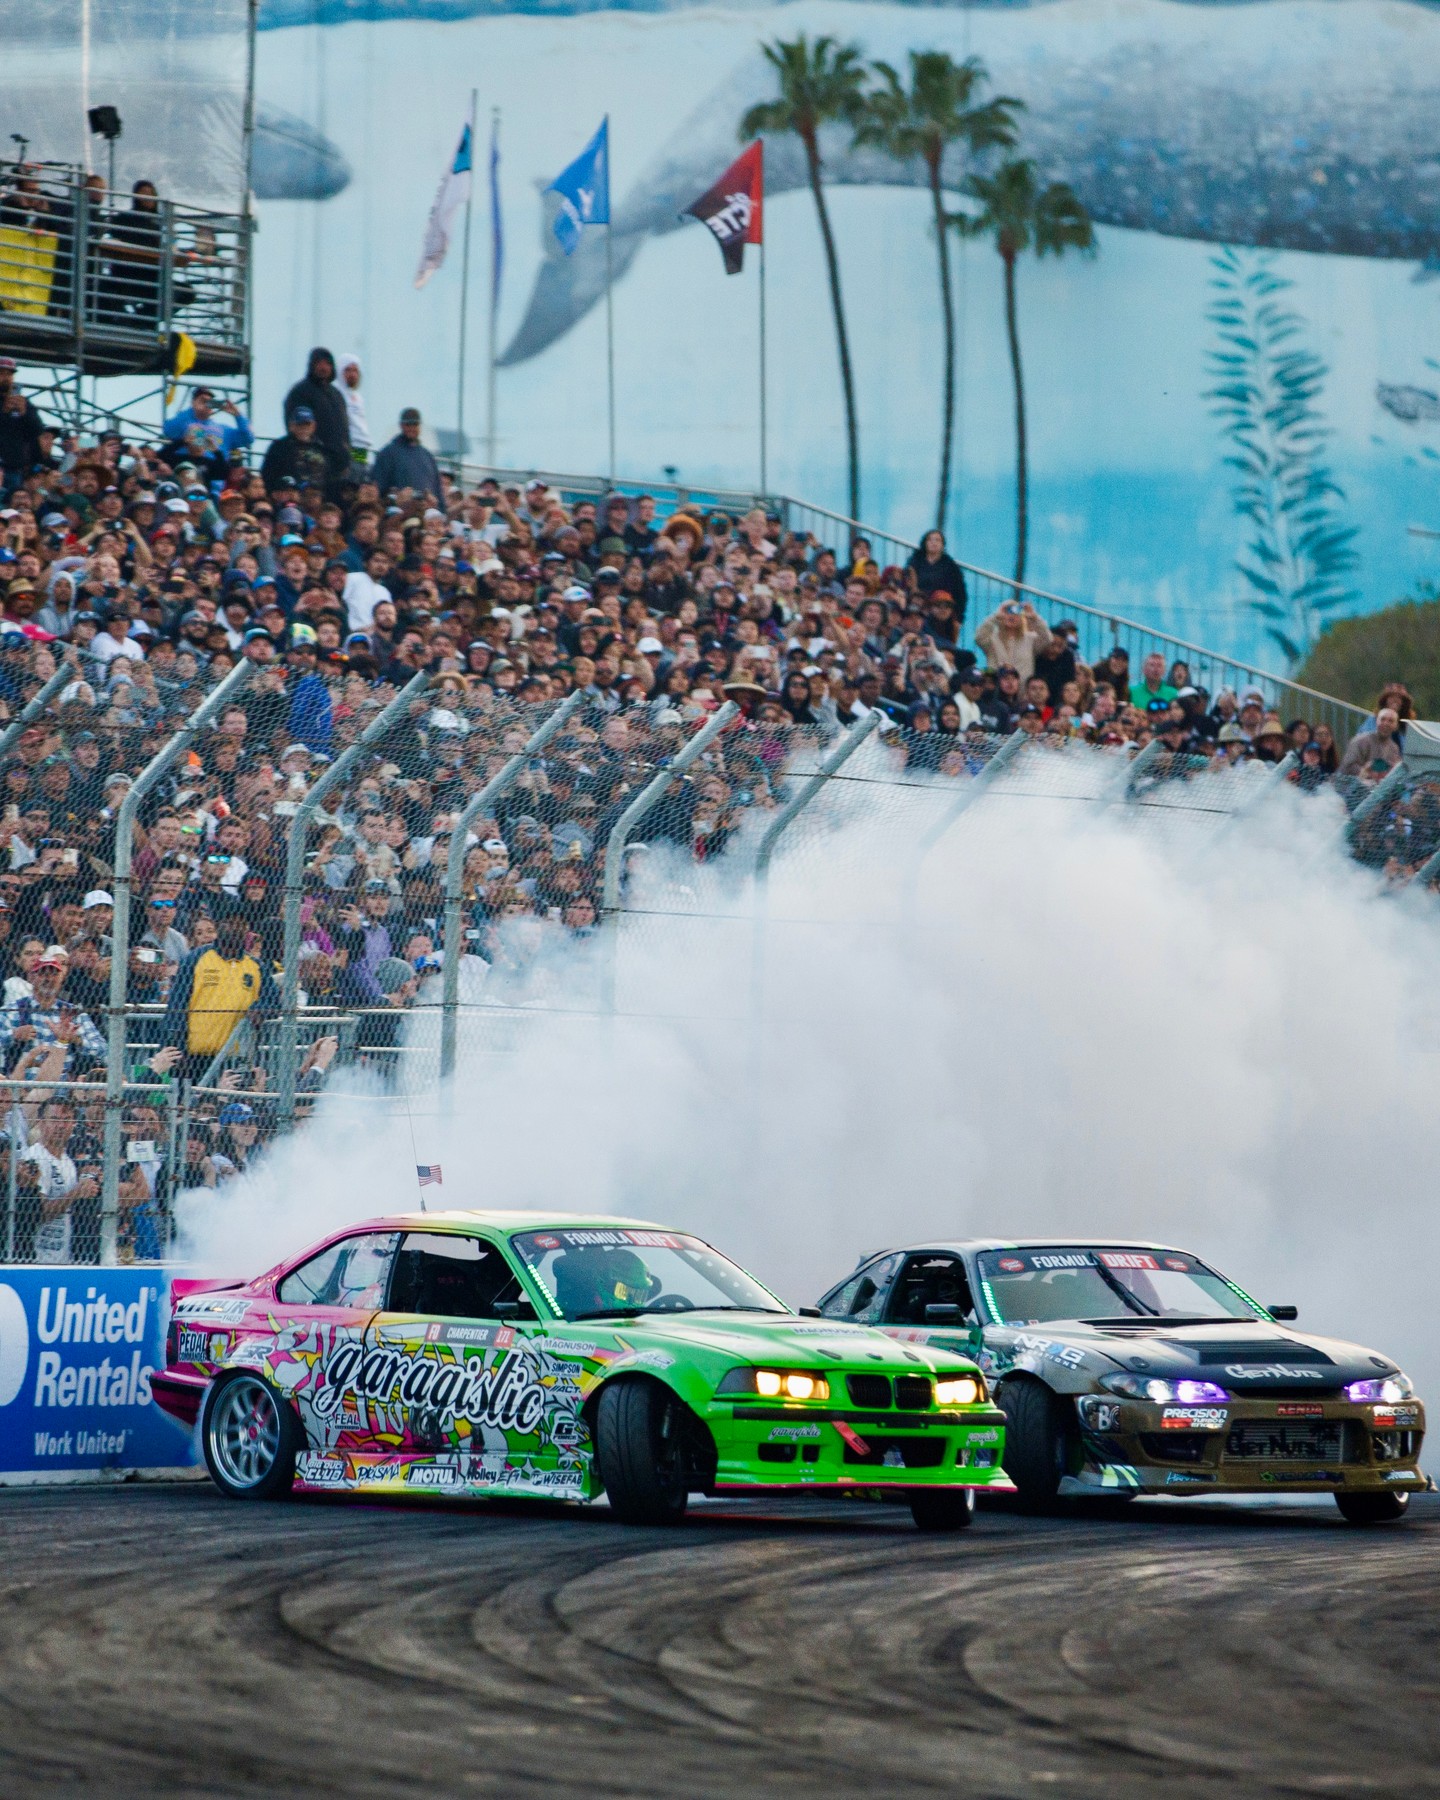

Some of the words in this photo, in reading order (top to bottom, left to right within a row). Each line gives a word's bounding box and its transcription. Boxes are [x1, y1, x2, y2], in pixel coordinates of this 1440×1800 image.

[563, 1231, 634, 1246] FORMULA
[628, 1231, 679, 1249] DRIFT
[1102, 1253, 1154, 1269] DRIFT
[37, 1287, 149, 1344] United
[180, 1333, 206, 1352] PEDAL
[446, 1327, 489, 1341] CHARPENTIER
[543, 1340, 595, 1351] MAGNUSON
[552, 1362, 580, 1374] SIMPSON
[34, 1351, 156, 1407] Rentals
[314, 1344, 543, 1432] garagistic
[334, 1413, 360, 1425] FEAL
[34, 1431, 73, 1456] Work
[76, 1429, 126, 1455] United
[410, 1468, 455, 1484] MOTUL
[467, 1465, 497, 1485] Holley
